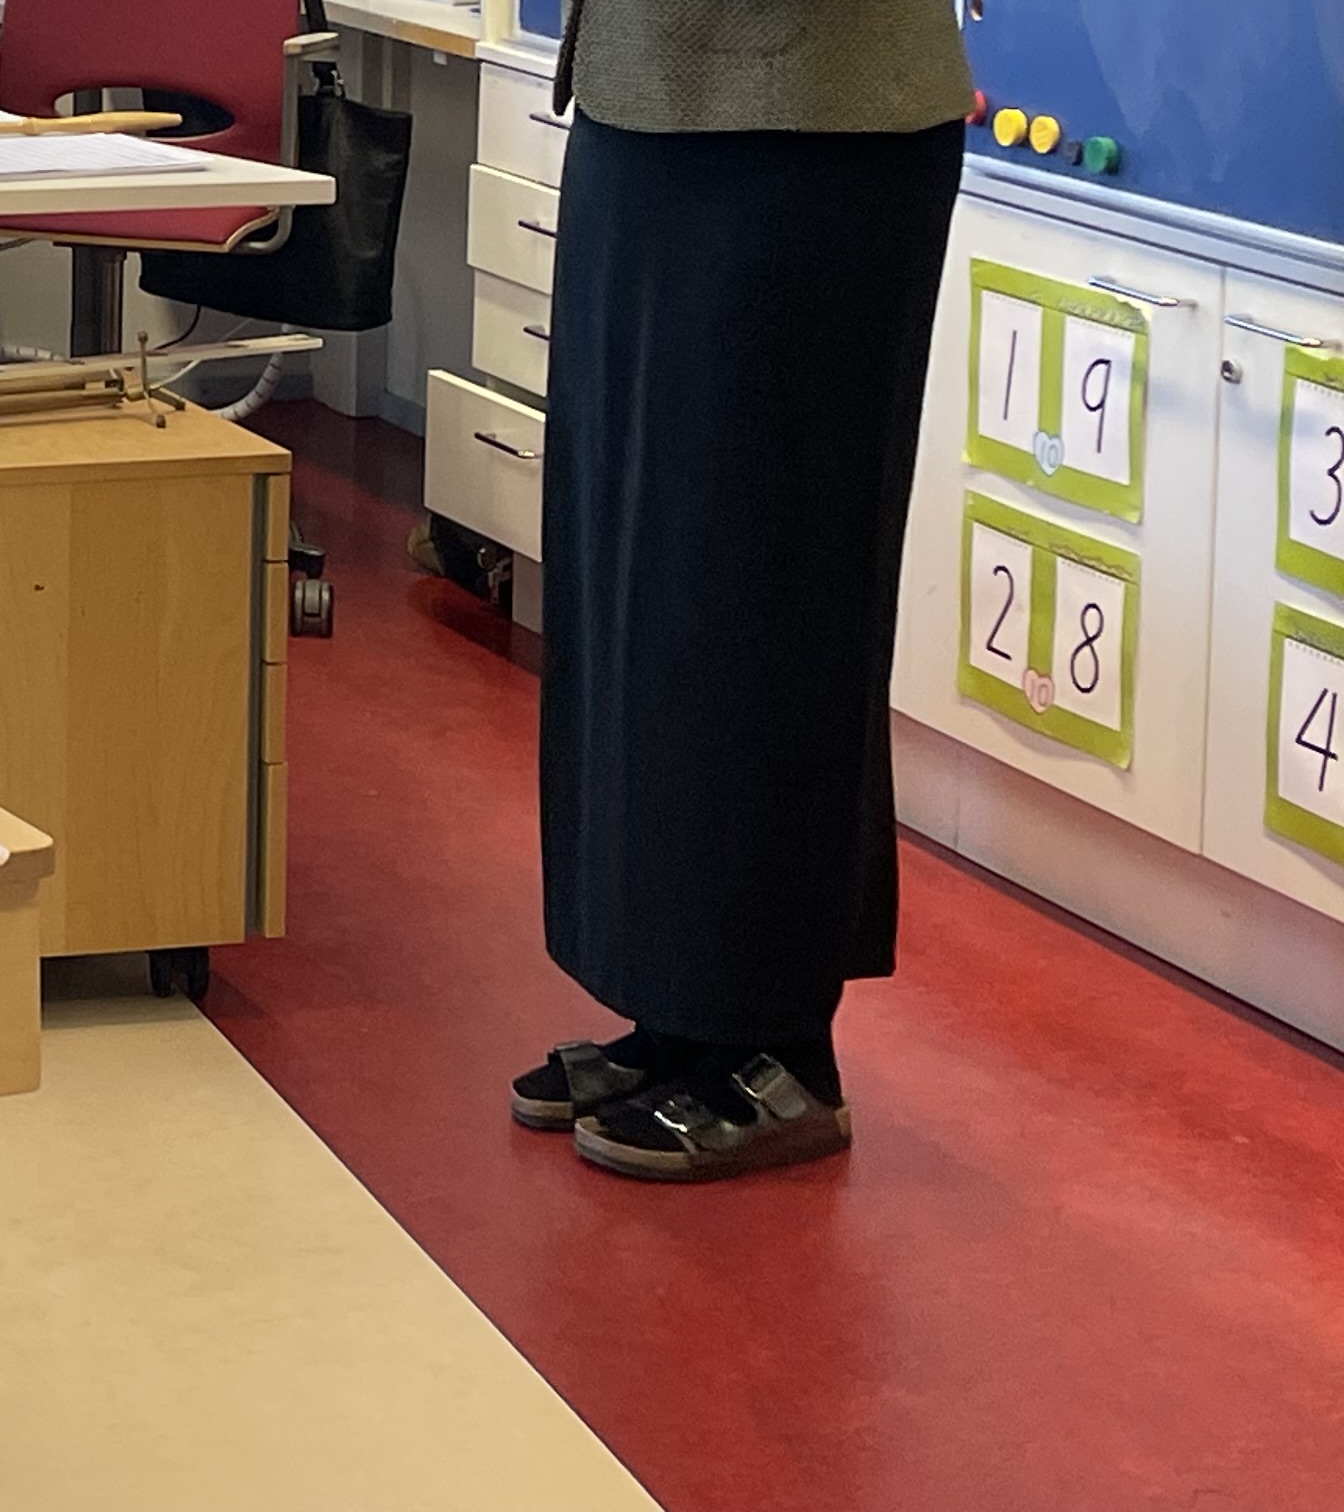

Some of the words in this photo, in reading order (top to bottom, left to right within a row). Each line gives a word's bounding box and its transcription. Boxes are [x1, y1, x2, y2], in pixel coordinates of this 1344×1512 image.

[1002, 329, 1018, 421] 1
[1081, 358, 1113, 454] 9
[1309, 425, 1344, 526] 3
[985, 564, 1015, 661] 2
[1069, 602, 1105, 694] 8
[1294, 687, 1339, 792] 4
